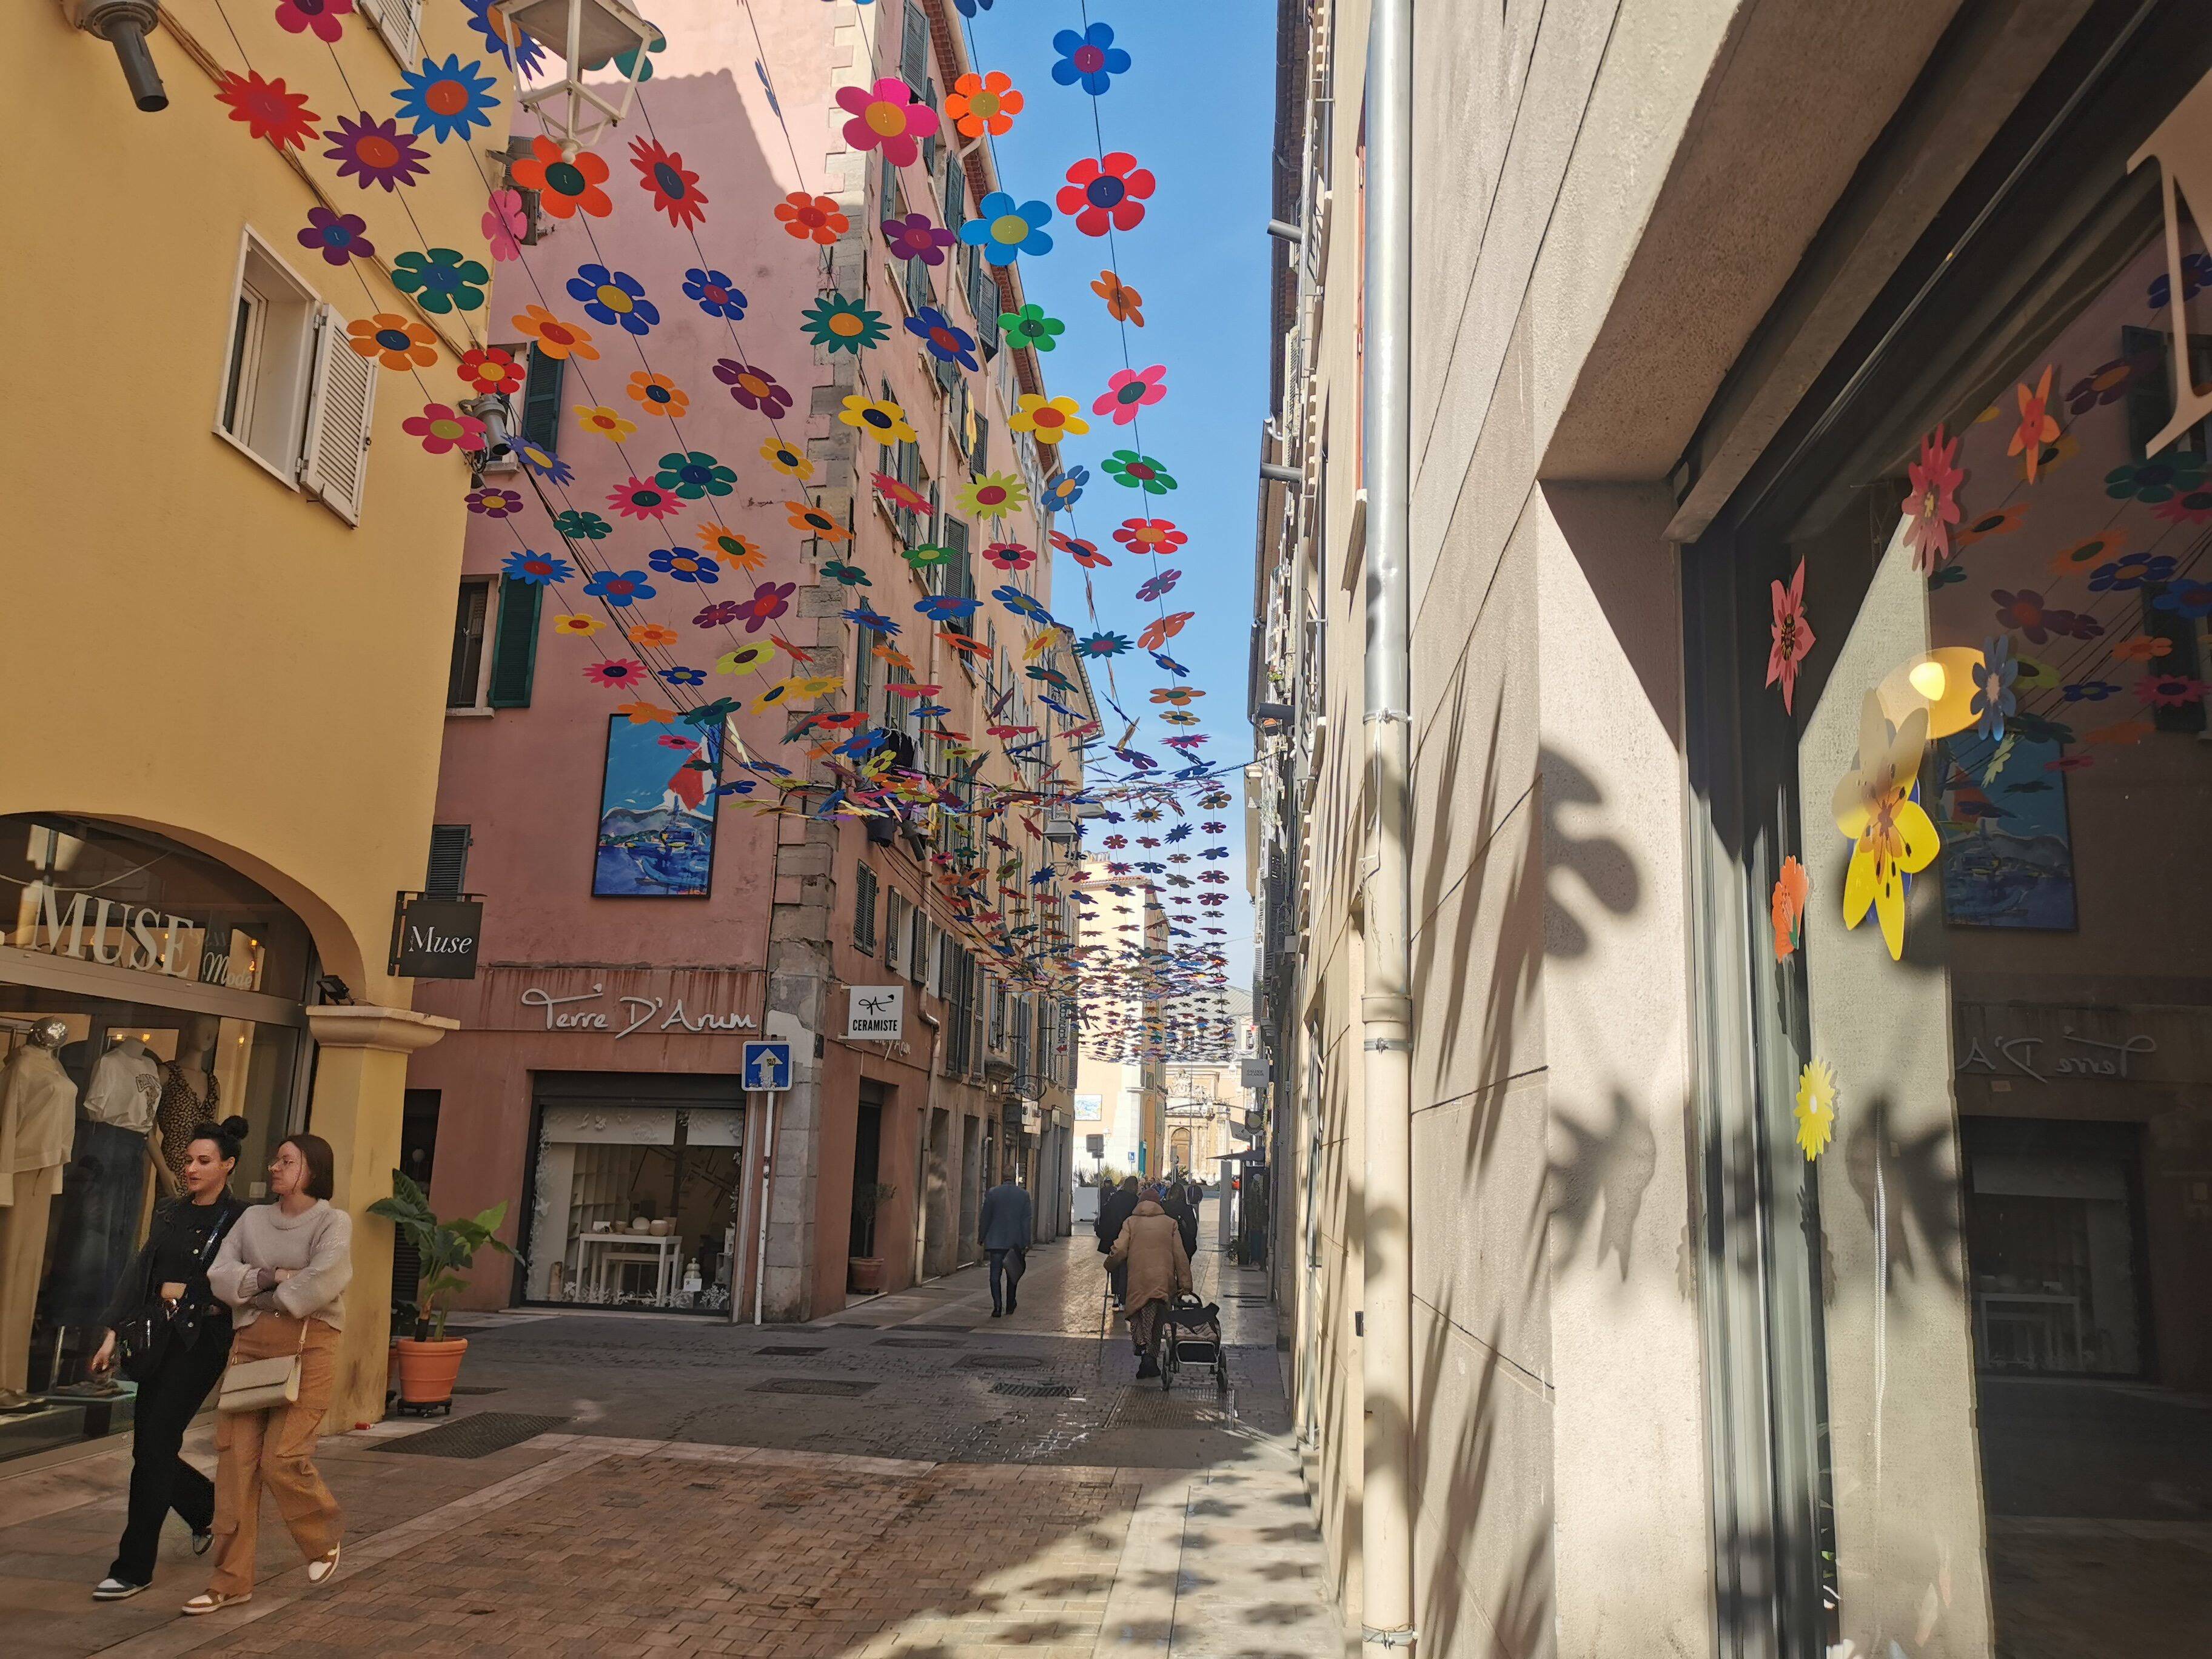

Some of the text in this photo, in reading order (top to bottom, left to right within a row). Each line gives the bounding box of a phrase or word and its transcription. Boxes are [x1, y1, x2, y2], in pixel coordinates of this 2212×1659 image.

[24, 884, 194, 977] MUSE
[408, 925, 472, 954] Muse
[203, 951, 253, 991] Mode
[521, 983, 757, 1039] Terre D'Arum
[853, 1019, 898, 1031] CERAMISTE
